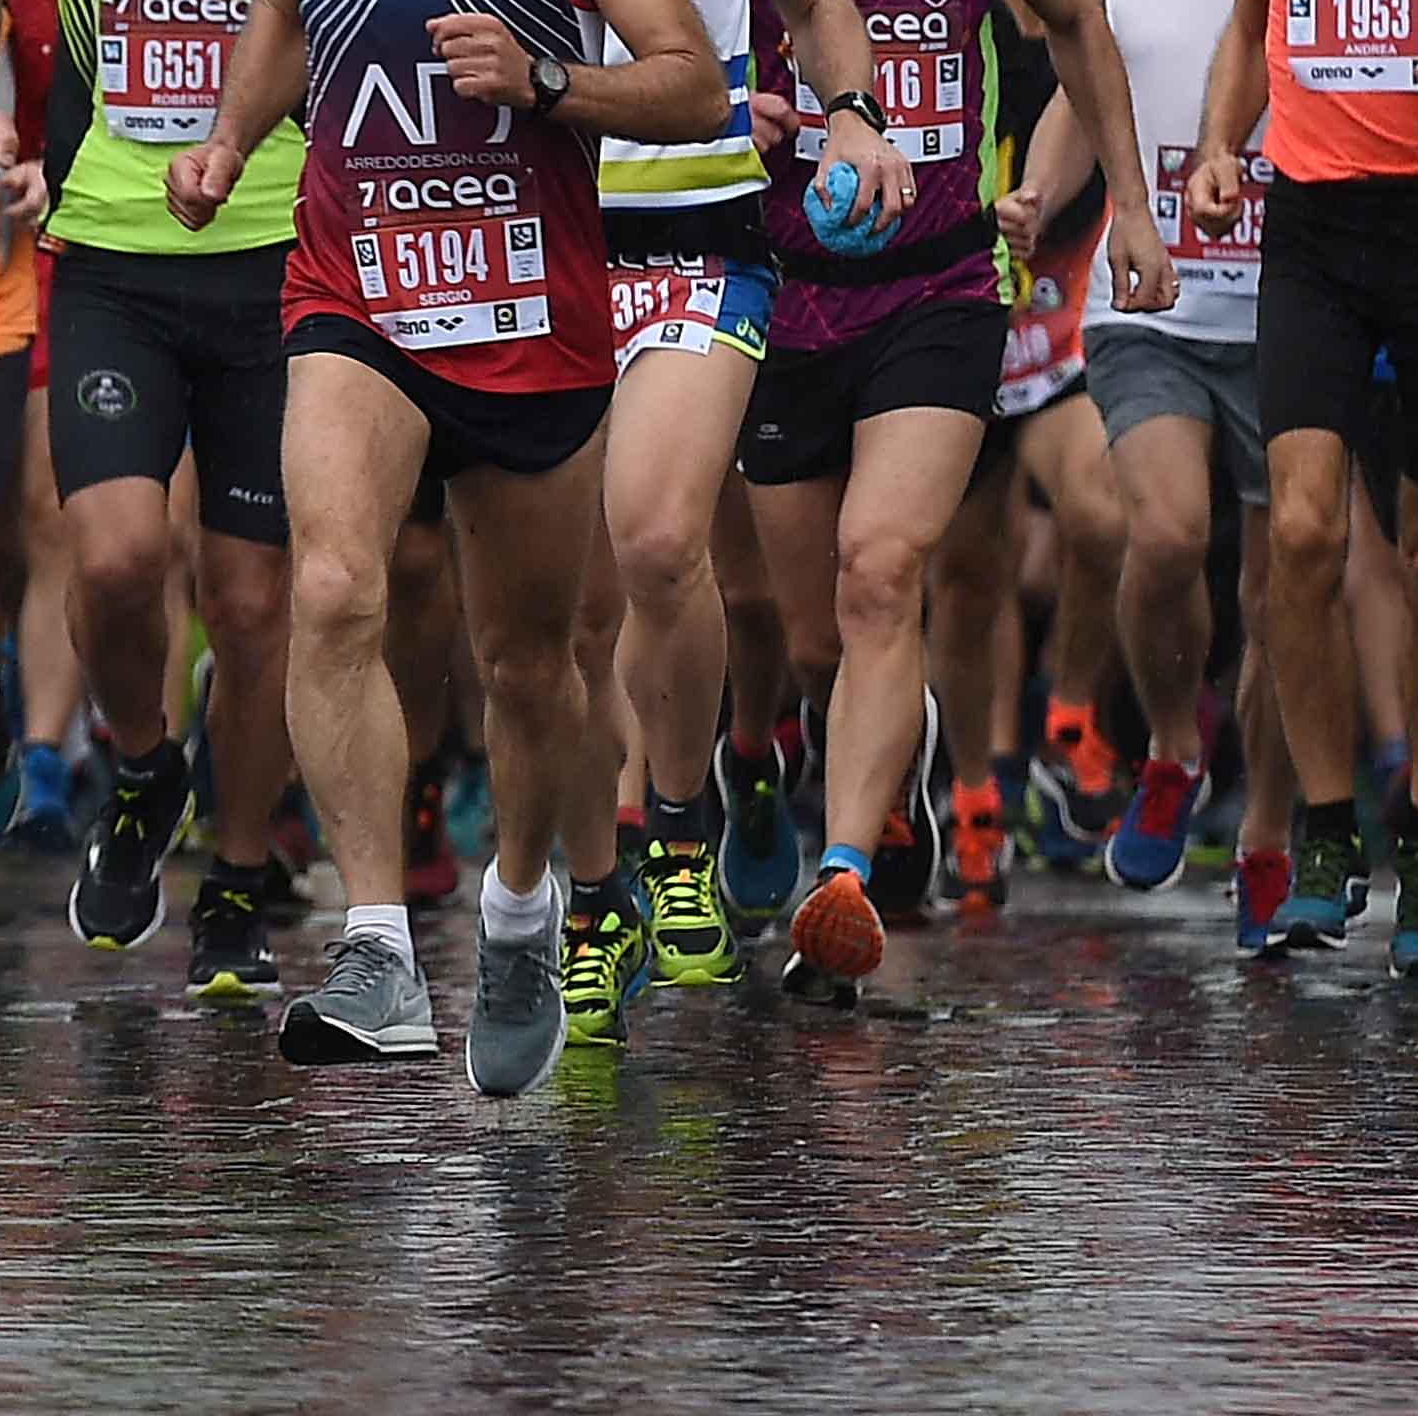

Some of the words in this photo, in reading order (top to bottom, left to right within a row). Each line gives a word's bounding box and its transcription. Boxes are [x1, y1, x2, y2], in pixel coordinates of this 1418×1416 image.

[866, 12, 948, 41] cea
[1344, 43, 1398, 56] ANDREA
[143, 39, 222, 90] 6551
[1311, 66, 1353, 79] arena
[874, 59, 922, 110] 16
[151, 93, 215, 106] ROBERTO
[124, 116, 165, 129] arena
[343, 151, 519, 171] ARREDODESIGN.COM
[358, 181, 376, 208] 7
[387, 172, 518, 211] acea
[395, 228, 489, 289] 5194
[418, 289, 473, 307] SERGIO
[610, 277, 671, 332] 351
